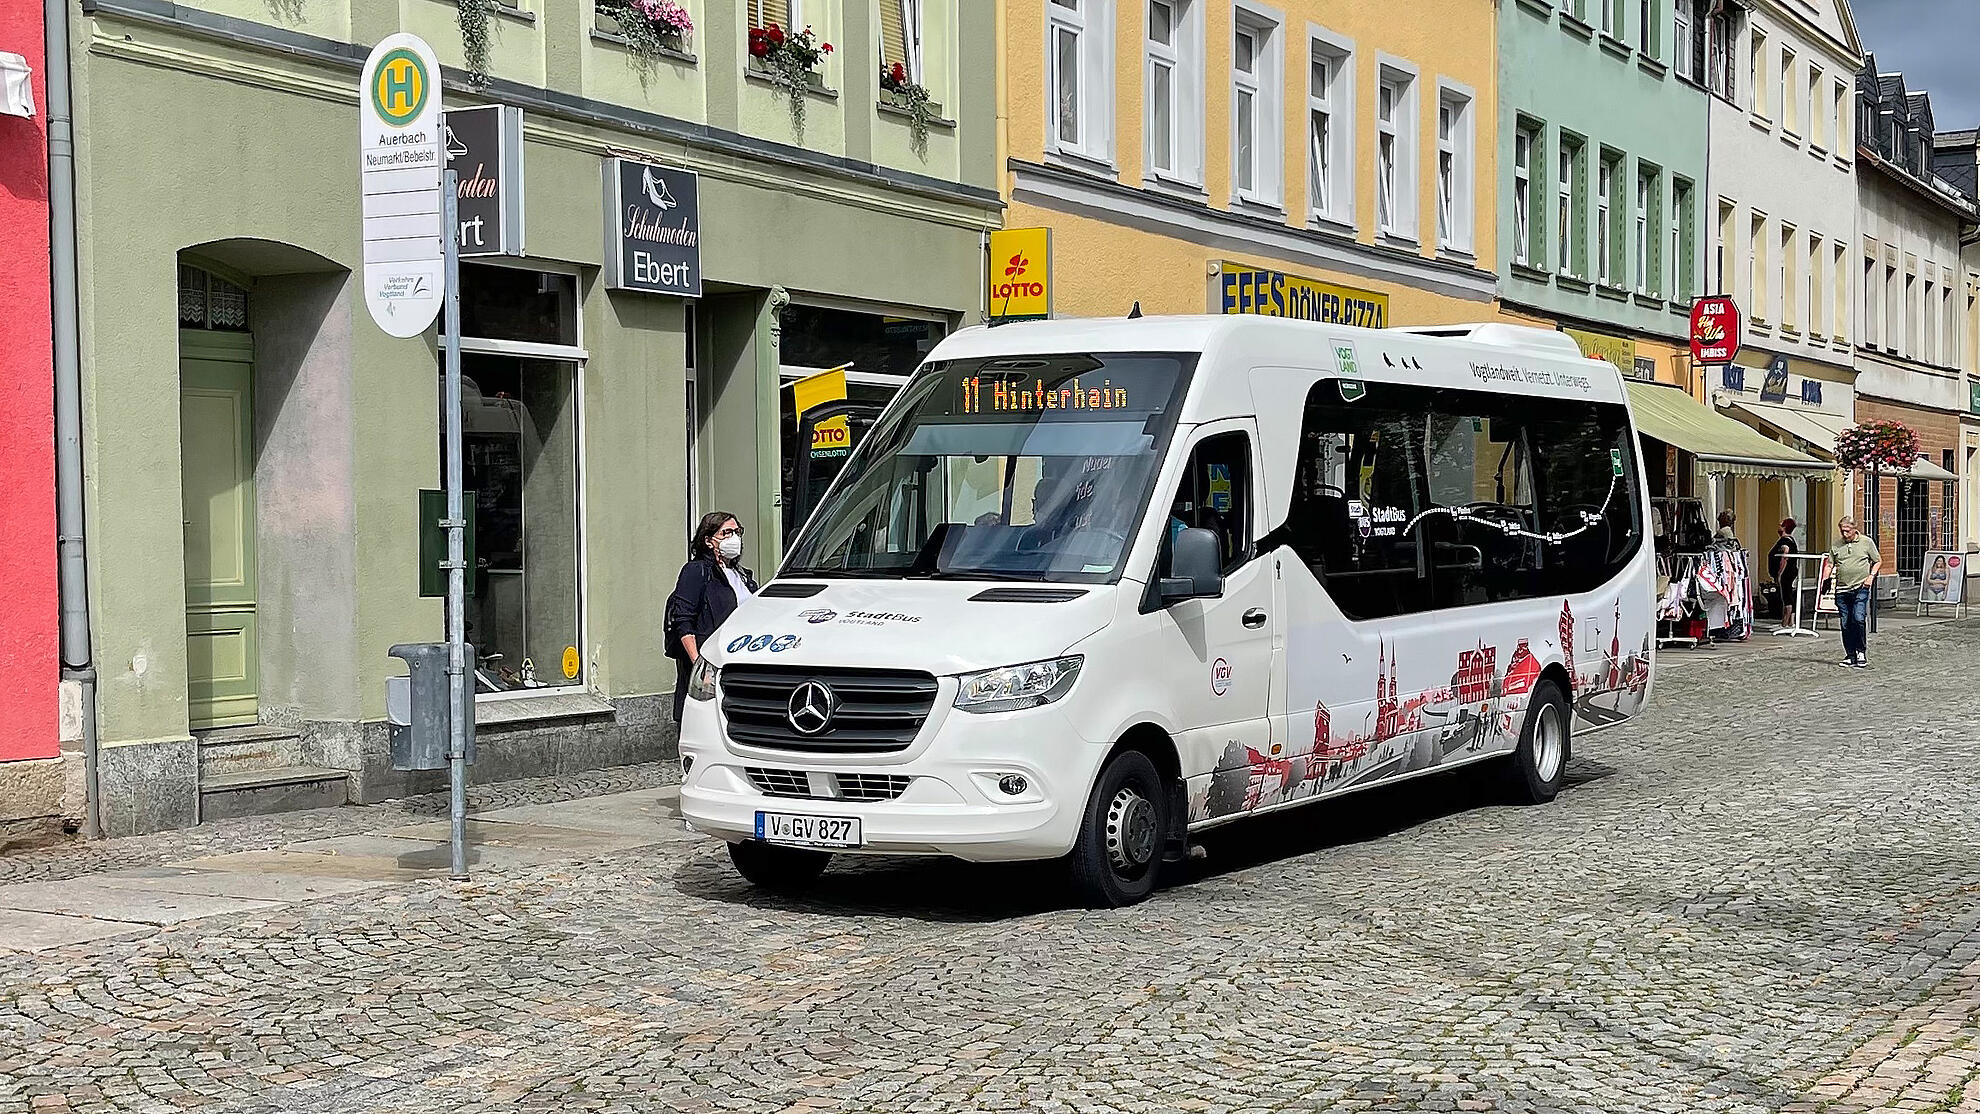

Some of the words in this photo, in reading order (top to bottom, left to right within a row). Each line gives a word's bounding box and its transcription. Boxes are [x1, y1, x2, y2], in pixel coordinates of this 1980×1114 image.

[379, 131, 426, 146] Auerbach
[457, 215, 485, 246] rt
[624, 204, 697, 247] Schuhmoden
[633, 250, 690, 288] Ebert
[992, 282, 1043, 298] LOTTO
[1703, 303, 1725, 315] ASIA
[1701, 347, 1727, 358] IMBISS
[962, 377, 979, 413] 11
[994, 378, 1127, 410] Hinterhain
[1372, 505, 1406, 523] StadtBus
[845, 611, 923, 623] StadtBus
[1215, 666, 1233, 680] VGV
[771, 816, 782, 836] V
[793, 818, 814, 838] GV
[819, 820, 852, 841] 827
